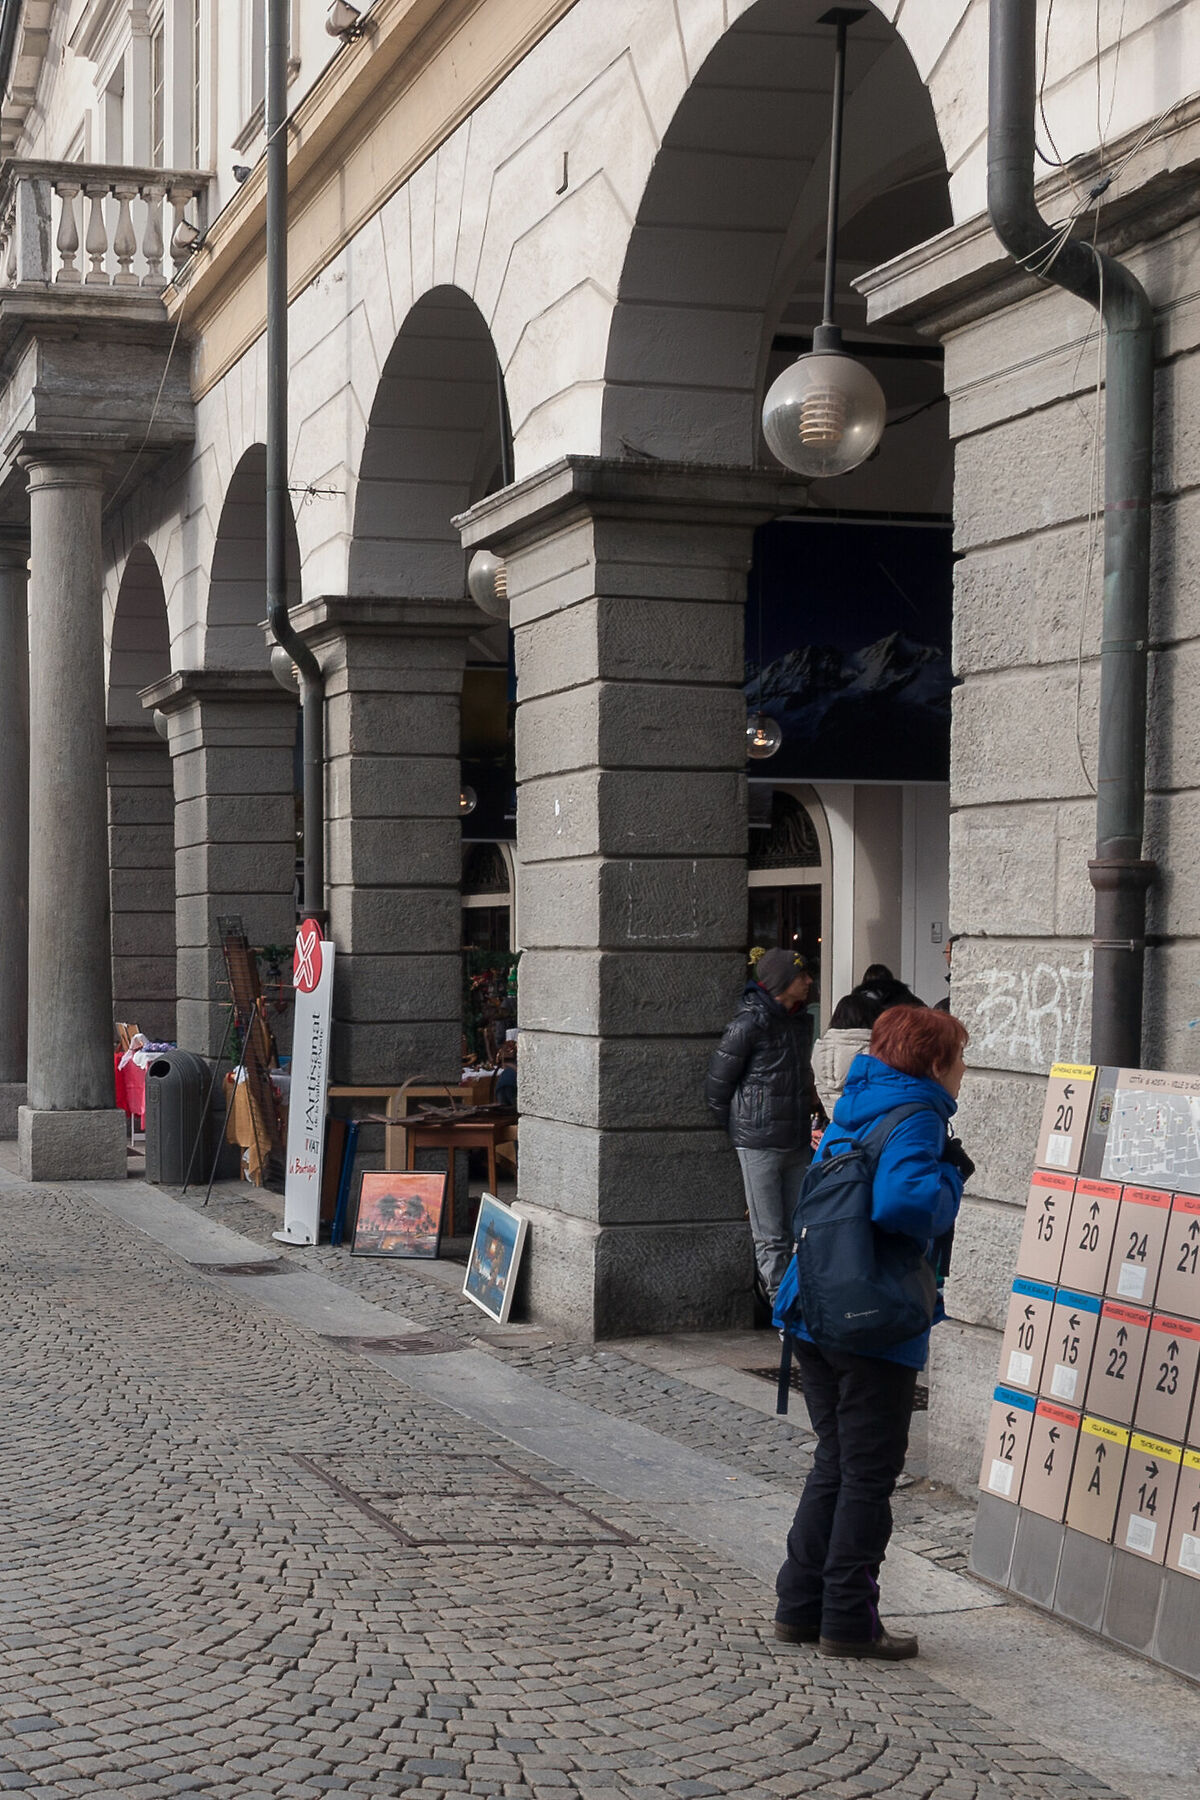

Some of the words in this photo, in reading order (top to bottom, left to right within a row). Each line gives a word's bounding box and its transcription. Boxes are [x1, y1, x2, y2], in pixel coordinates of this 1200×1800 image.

[1053, 1104, 1073, 1132] 20
[1037, 1213, 1055, 1242] 15
[1079, 1222, 1100, 1252] 20
[1126, 1231, 1148, 1262] 24
[1177, 1242, 1199, 1274] 21
[1018, 1321, 1035, 1351] 10
[1062, 1334, 1080, 1365] 15
[1105, 1347, 1128, 1380] 22
[1155, 1362, 1180, 1396] 23
[999, 1430, 1016, 1461] 12
[1043, 1448, 1055, 1476] 4
[1087, 1464, 1102, 1496] A
[1138, 1482, 1158, 1516] 14
